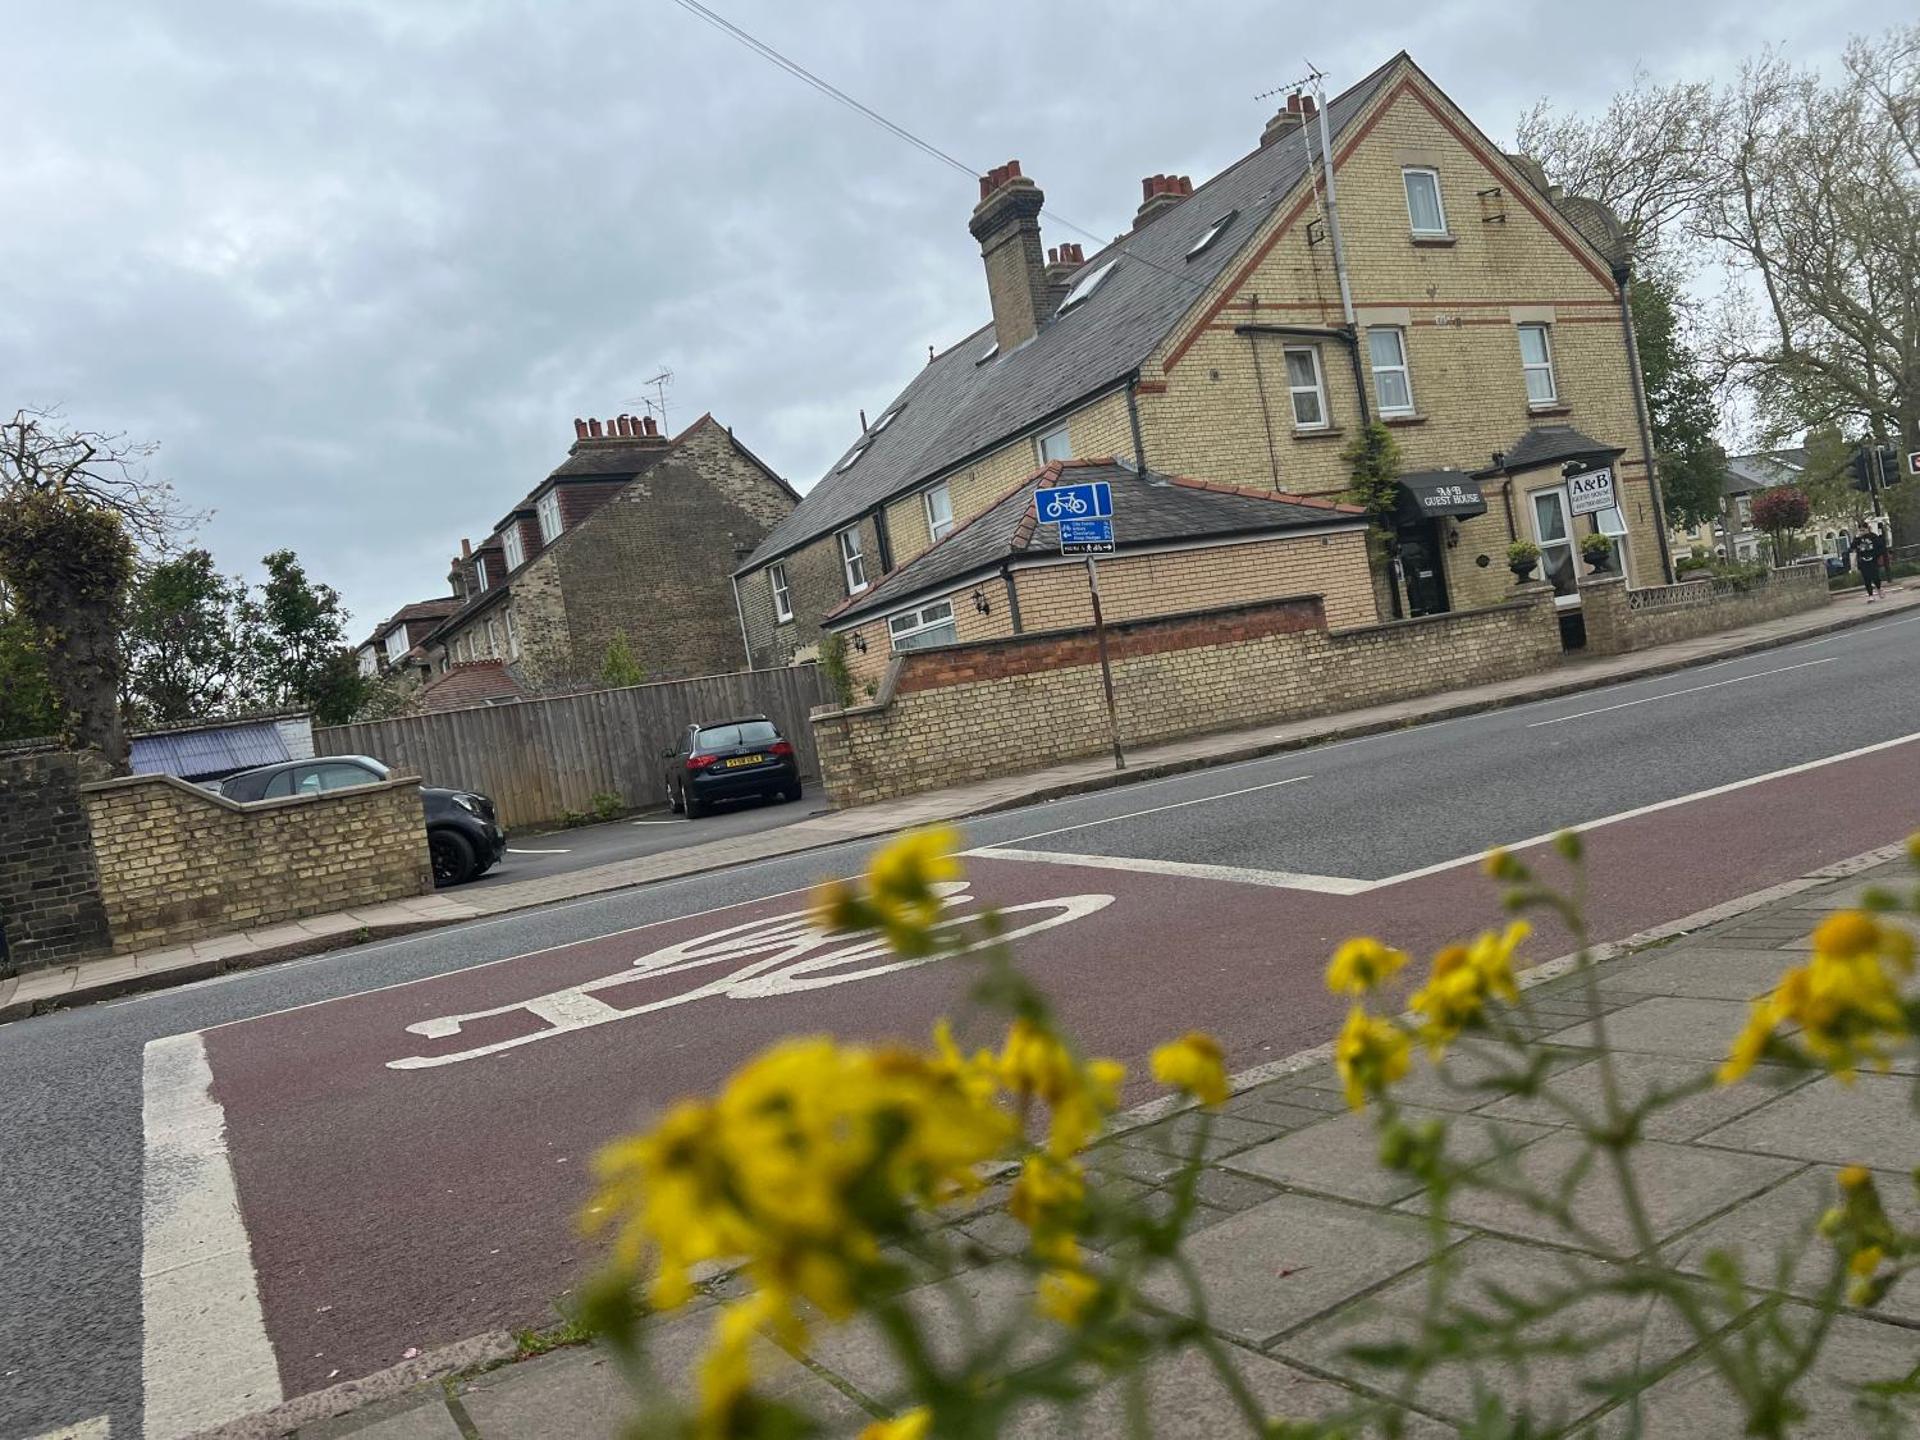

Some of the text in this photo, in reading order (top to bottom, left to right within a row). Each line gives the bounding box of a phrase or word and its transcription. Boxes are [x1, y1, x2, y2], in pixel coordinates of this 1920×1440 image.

[1572, 474, 1609, 495] A&B
[1424, 493, 1480, 506] GUEST HOUSE
